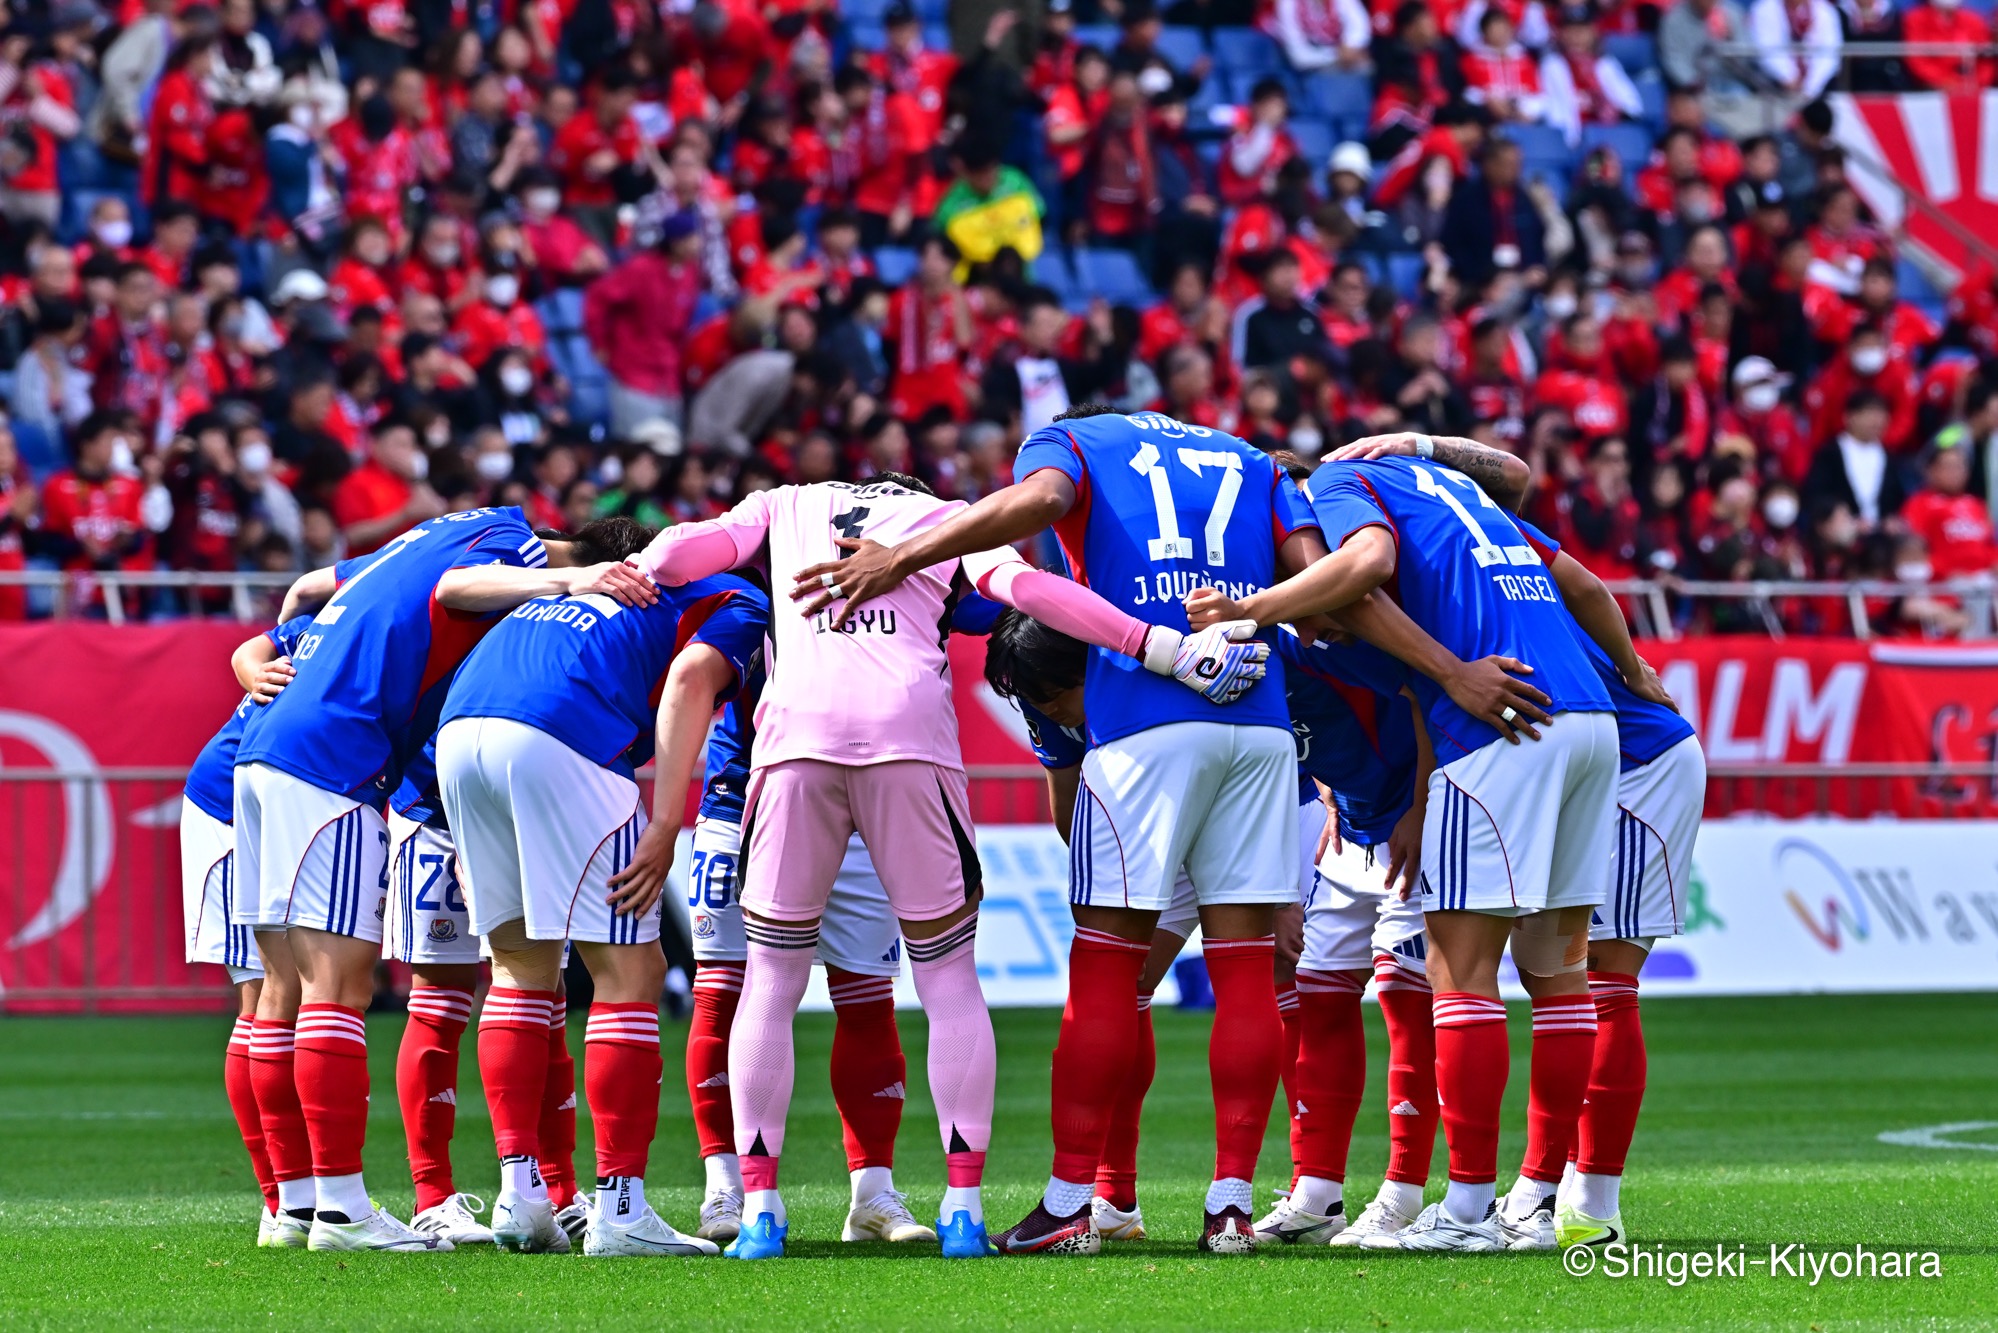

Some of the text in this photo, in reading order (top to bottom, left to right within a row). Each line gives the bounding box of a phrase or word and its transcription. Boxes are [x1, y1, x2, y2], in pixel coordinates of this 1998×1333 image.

[1128, 442, 1244, 567] 17
[1492, 574, 1557, 603] TAISEI
[501, 602, 598, 632] UNODA
[688, 850, 736, 909] 30
